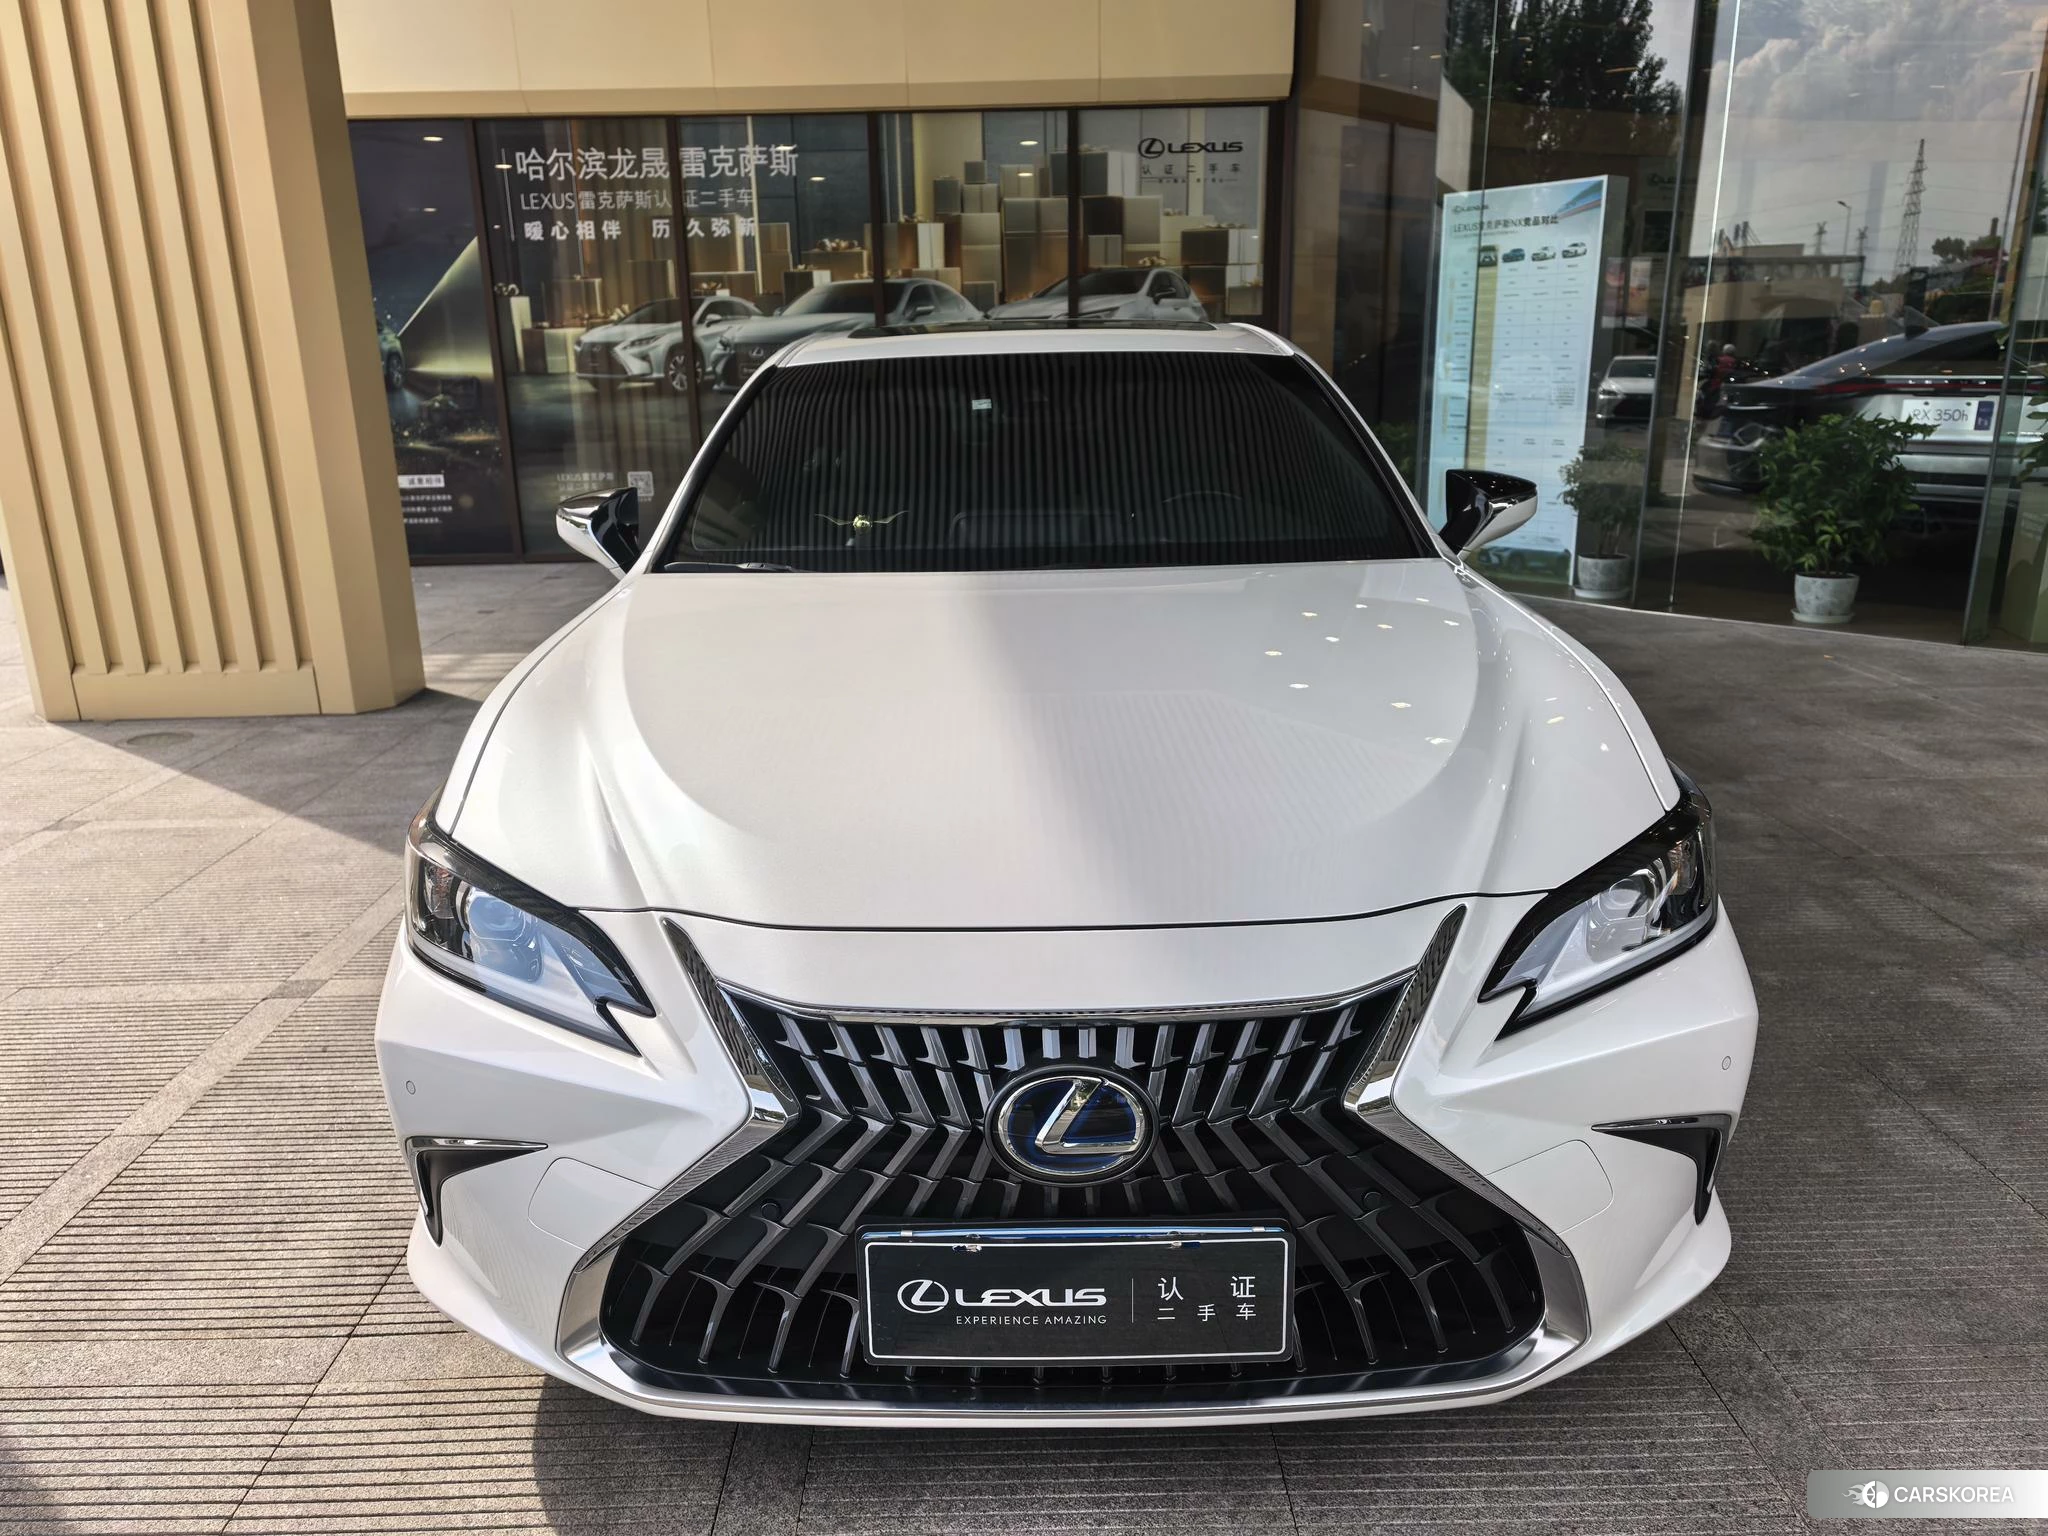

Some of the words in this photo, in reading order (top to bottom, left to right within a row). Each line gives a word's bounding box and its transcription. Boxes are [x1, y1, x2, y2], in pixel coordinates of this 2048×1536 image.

[1167, 142, 1243, 154] LEXUS
[515, 146, 670, 181] 哈尔滨龙晟
[680, 144, 799, 178] 雷克萨斯
[520, 192, 575, 210] LEXUS
[524, 219, 622, 241] 暖心相伴
[1912, 408, 1930, 421] RX
[1934, 408, 1969, 422] 350h
[955, 1288, 1107, 1307] LEXUS
[1158, 1276, 1256, 1301] 认证
[956, 1315, 1039, 1325] EXPERIENCE
[1045, 1315, 1107, 1325] AMAZING
[1157, 1302, 1257, 1322] 二手车
